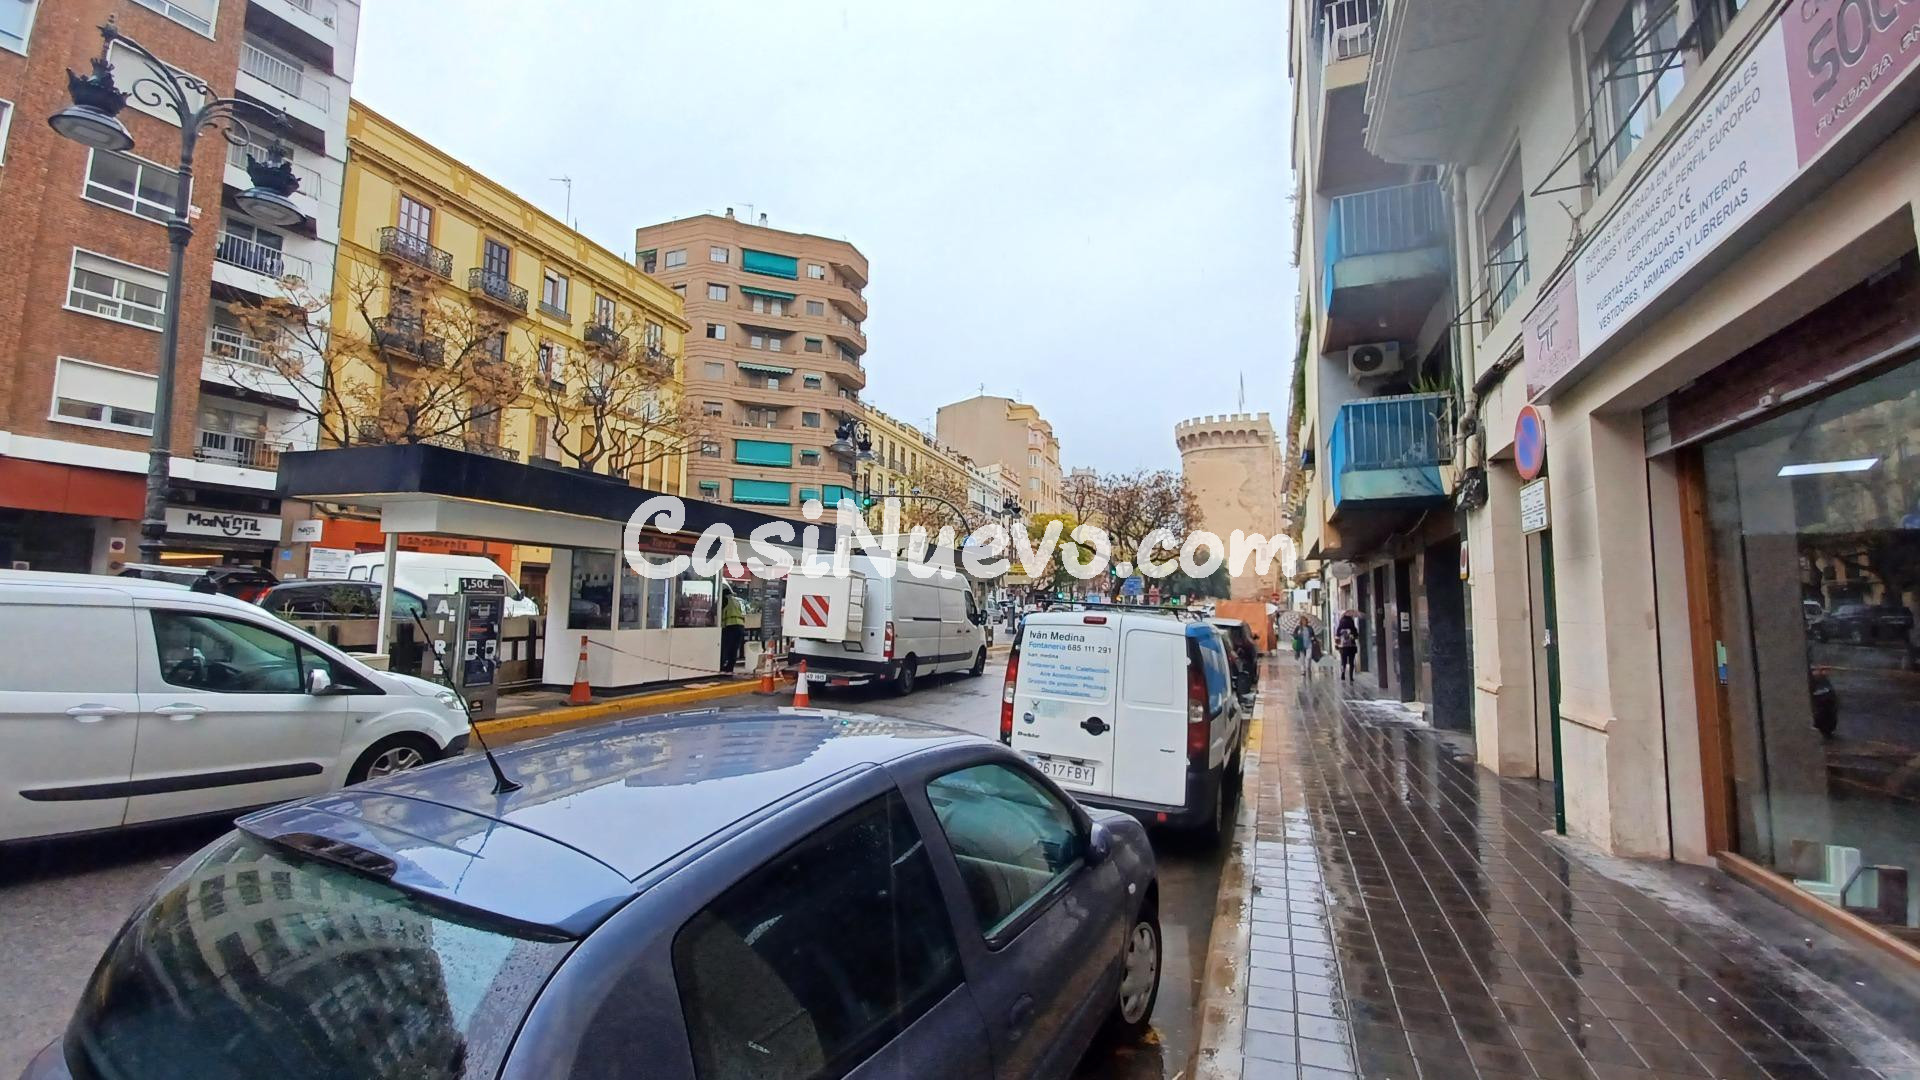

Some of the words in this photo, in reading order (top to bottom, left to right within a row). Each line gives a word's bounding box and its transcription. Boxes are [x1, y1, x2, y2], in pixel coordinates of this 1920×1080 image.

[1622, 183, 1656, 226] ENTRADA
[1669, 113, 1714, 171] MADERAS
[1715, 61, 1759, 117] NOBLES
[1623, 198, 1662, 246] VENTANAS
[1662, 182, 1675, 204] DE
[1675, 146, 1708, 189] PERFIL
[1708, 86, 1762, 152] EUROPEO
[1595, 279, 1625, 314] PUERTAS
[1624, 229, 1676, 288] ACORAZADAS
[1684, 207, 1698, 231] DE
[1700, 160, 1749, 217] INTERIOR
[1626, 203, 1677, 263] CERTIFICADO
[1643, 245, 1685, 292] ARMARIOS
[1695, 187, 1750, 247] LIBRERIAS
[462, 578, 490, 590] 1,50€
[1029, 630, 1048, 640] Iván
[1050, 631, 1085, 643] Medina
[1067, 644, 1081, 652] 685
[1084, 645, 1095, 653] 111
[1097, 646, 1111, 654] 291
[1067, 766, 1090, 781] FBY
